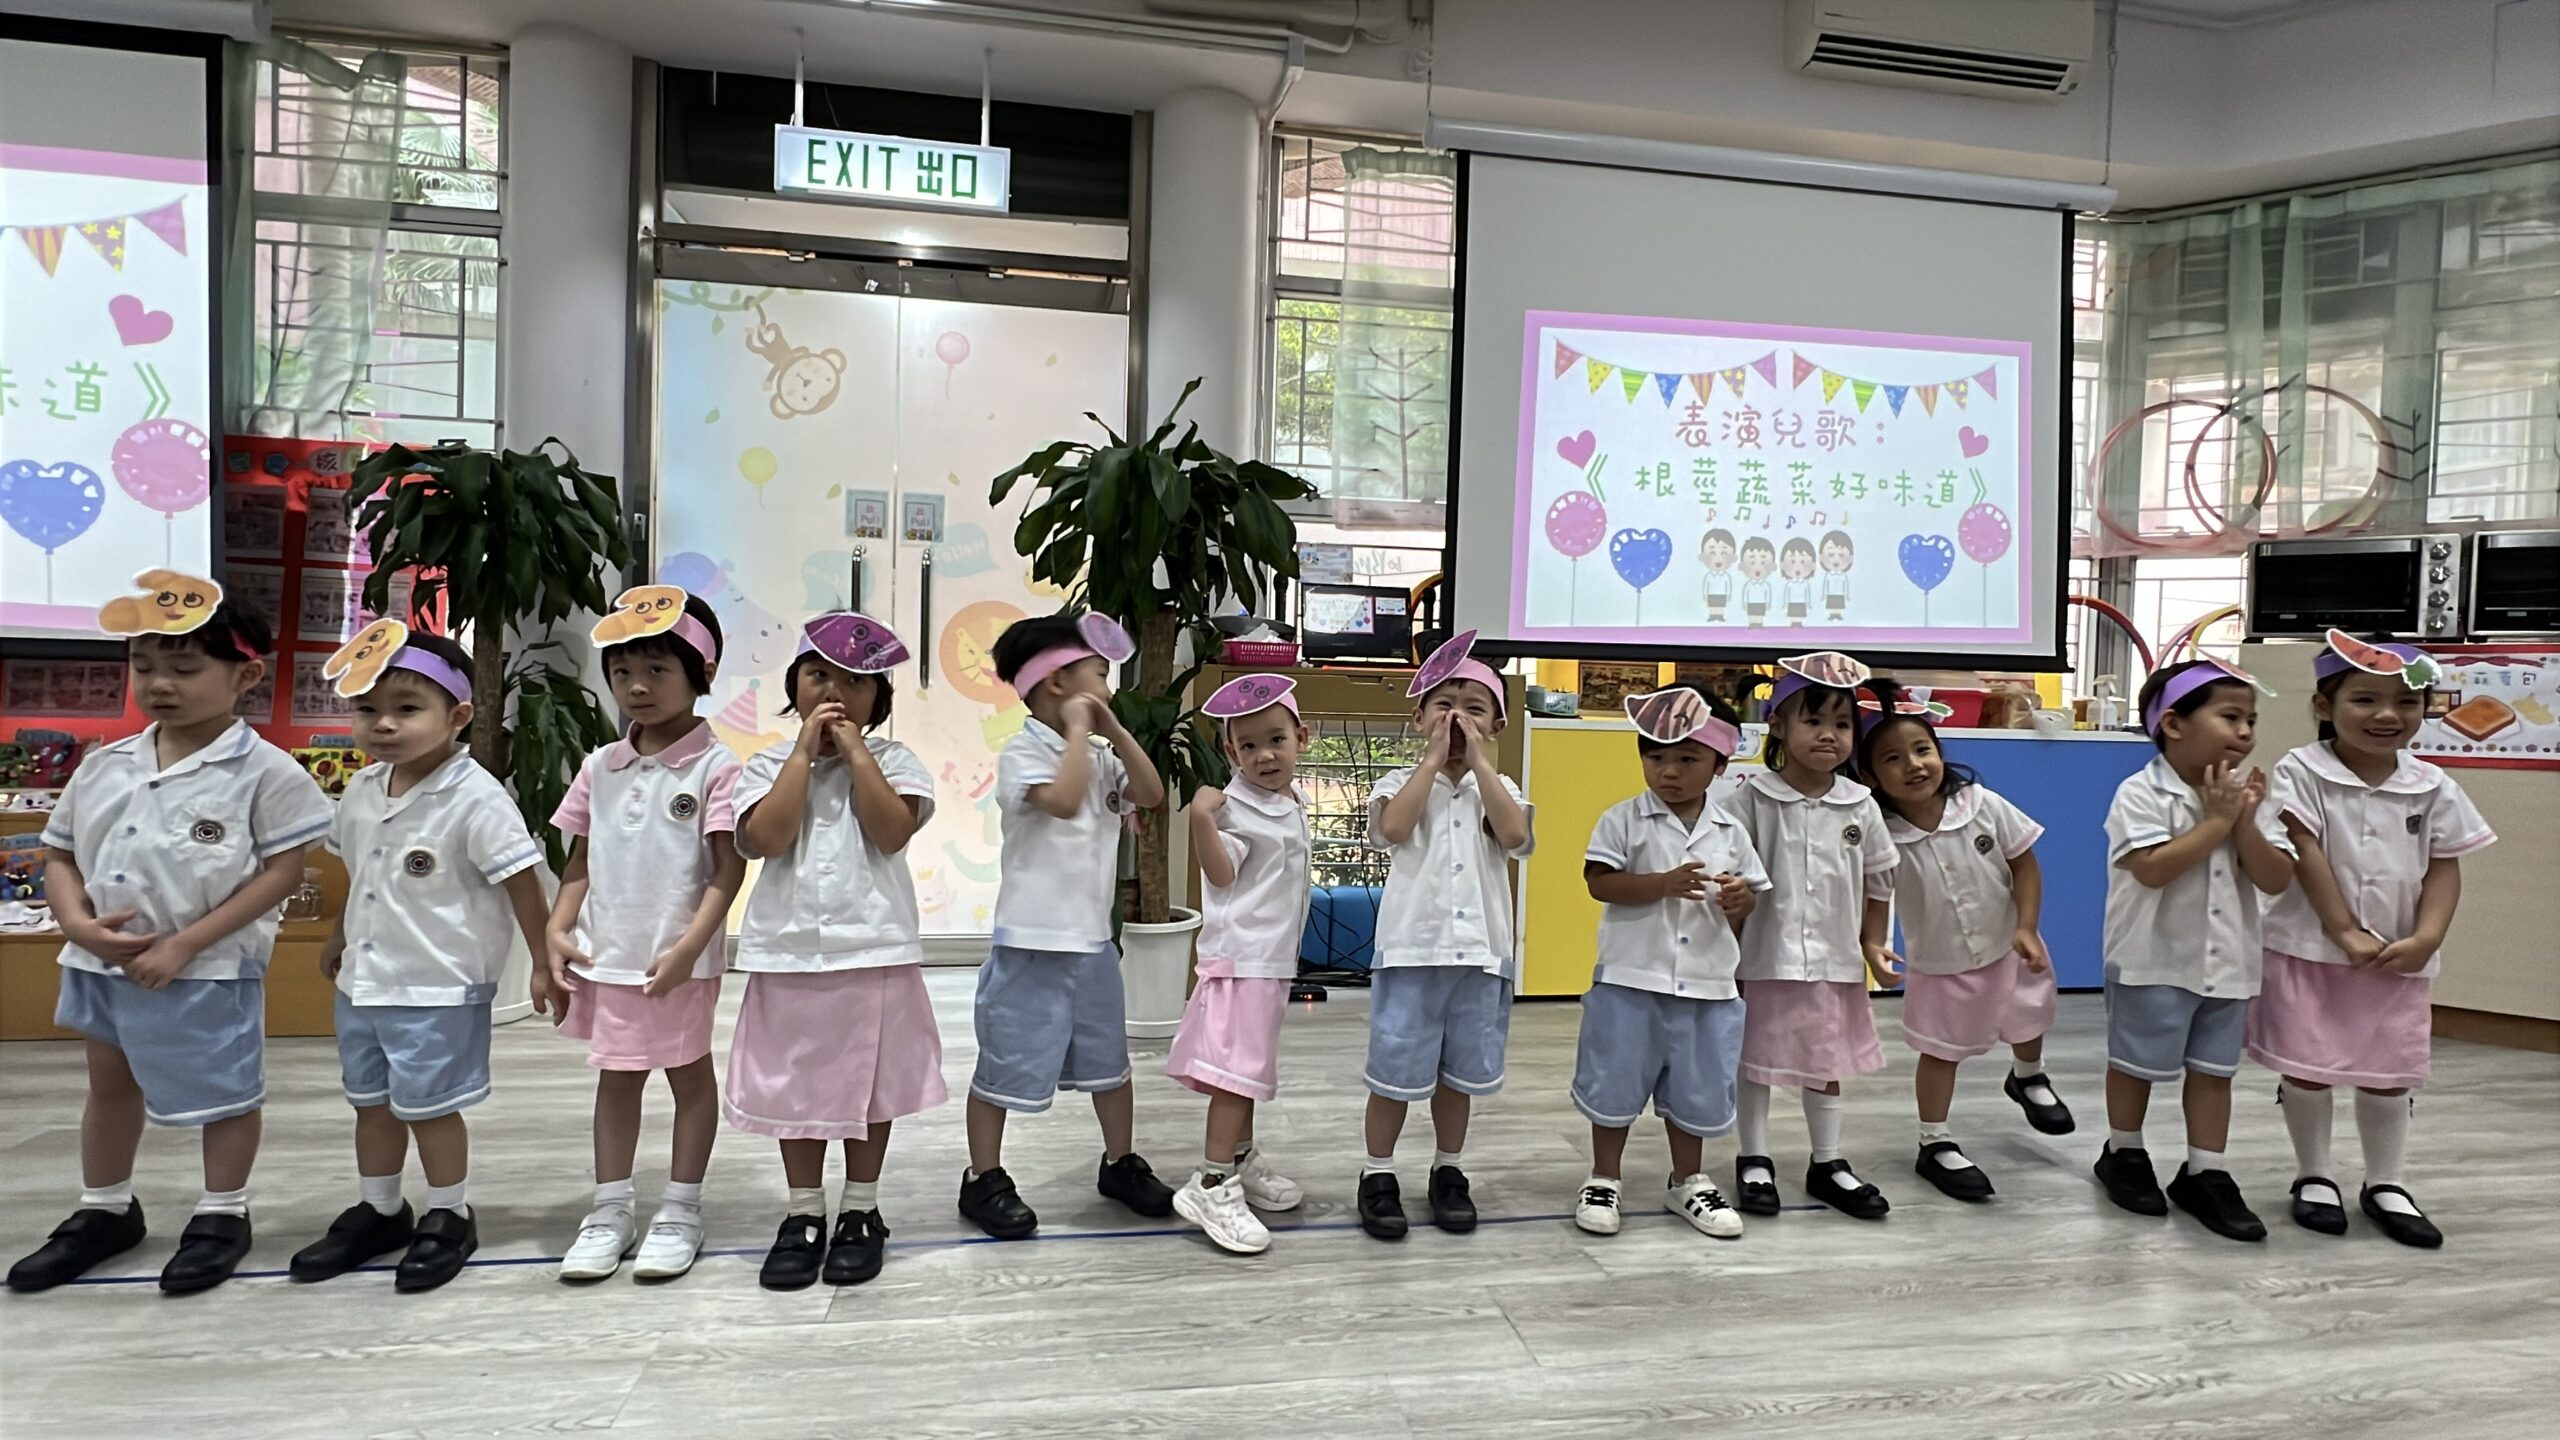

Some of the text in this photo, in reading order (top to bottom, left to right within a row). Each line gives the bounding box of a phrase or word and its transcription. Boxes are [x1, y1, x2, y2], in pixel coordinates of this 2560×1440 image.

[808, 138, 978, 199] EXIT 出口
[1675, 400, 1885, 451] 表演兒歌：
